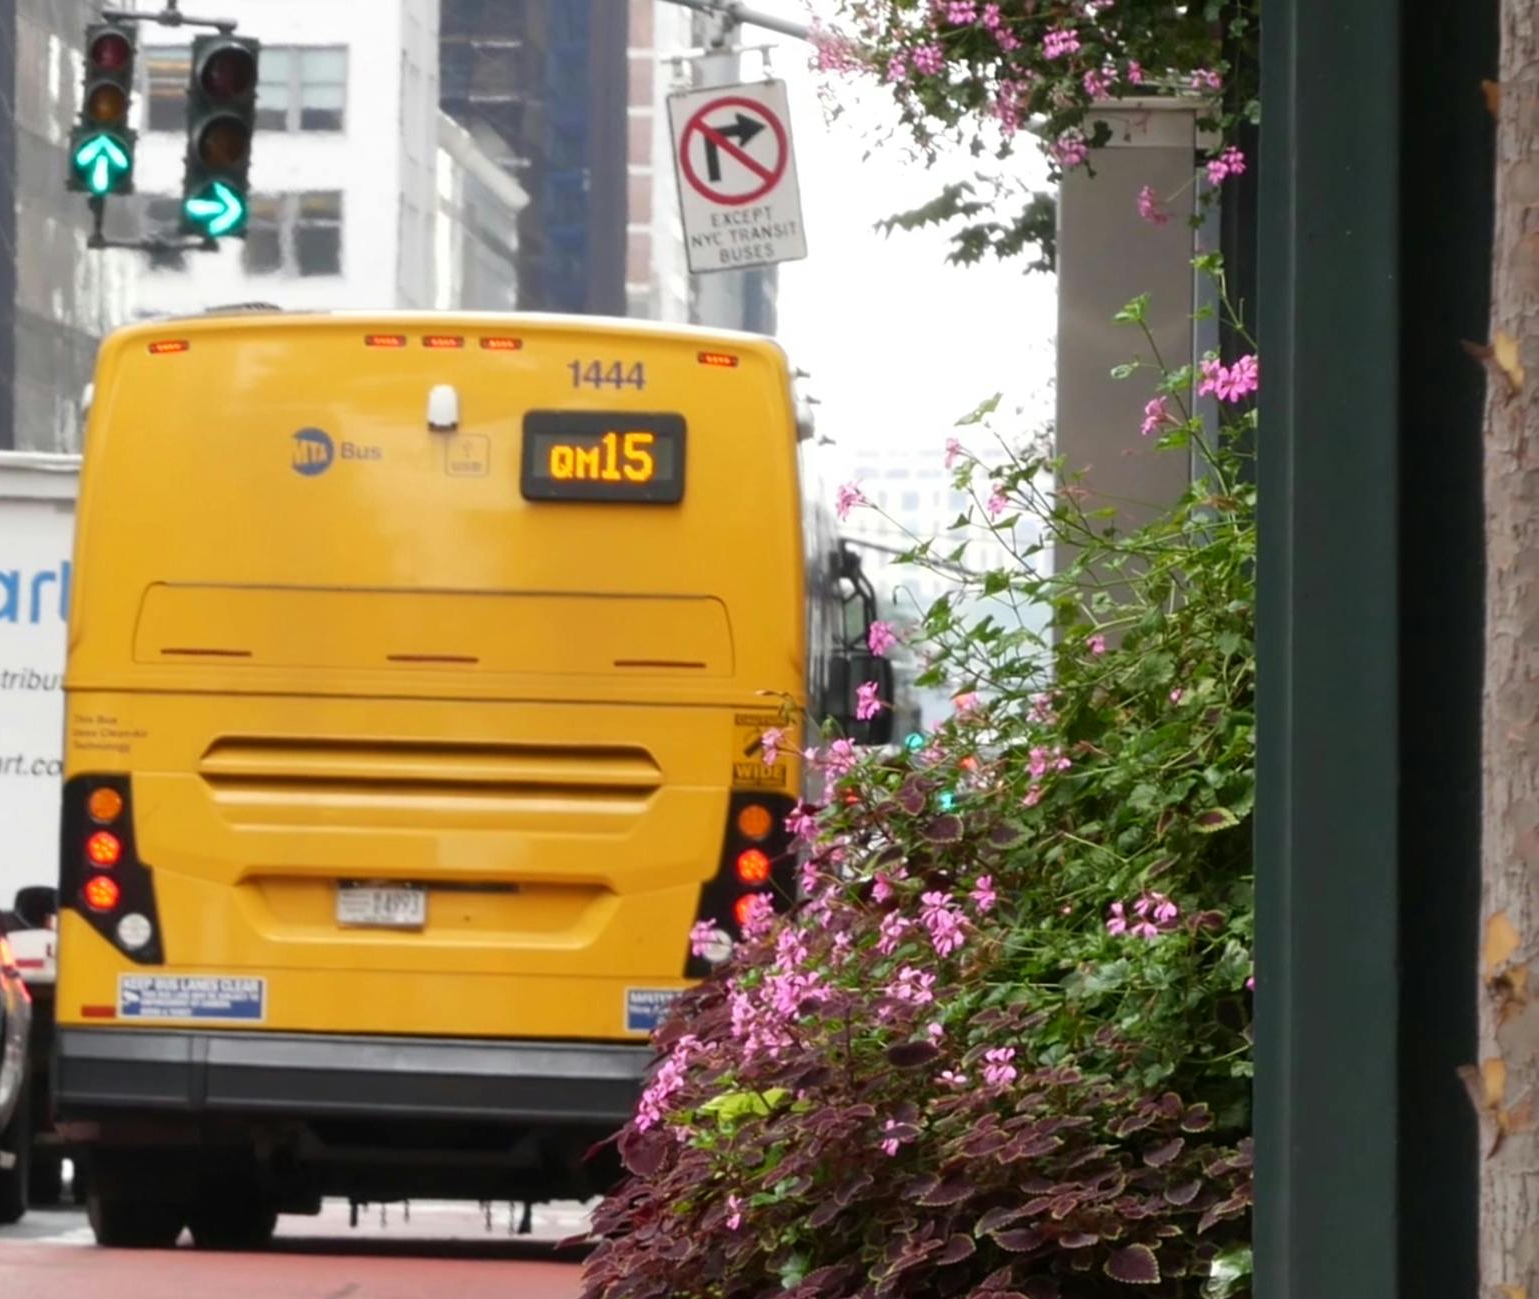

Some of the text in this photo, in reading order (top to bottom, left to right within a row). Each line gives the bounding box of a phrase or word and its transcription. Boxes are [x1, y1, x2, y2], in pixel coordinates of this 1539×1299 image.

[710, 206, 772, 228] EXCEPT
[690, 221, 797, 248] NYC TRANSIT
[719, 243, 775, 263] BUSES
[567, 360, 646, 390] 1444
[340, 442, 382, 460] Bus
[550, 432, 654, 481] QM15
